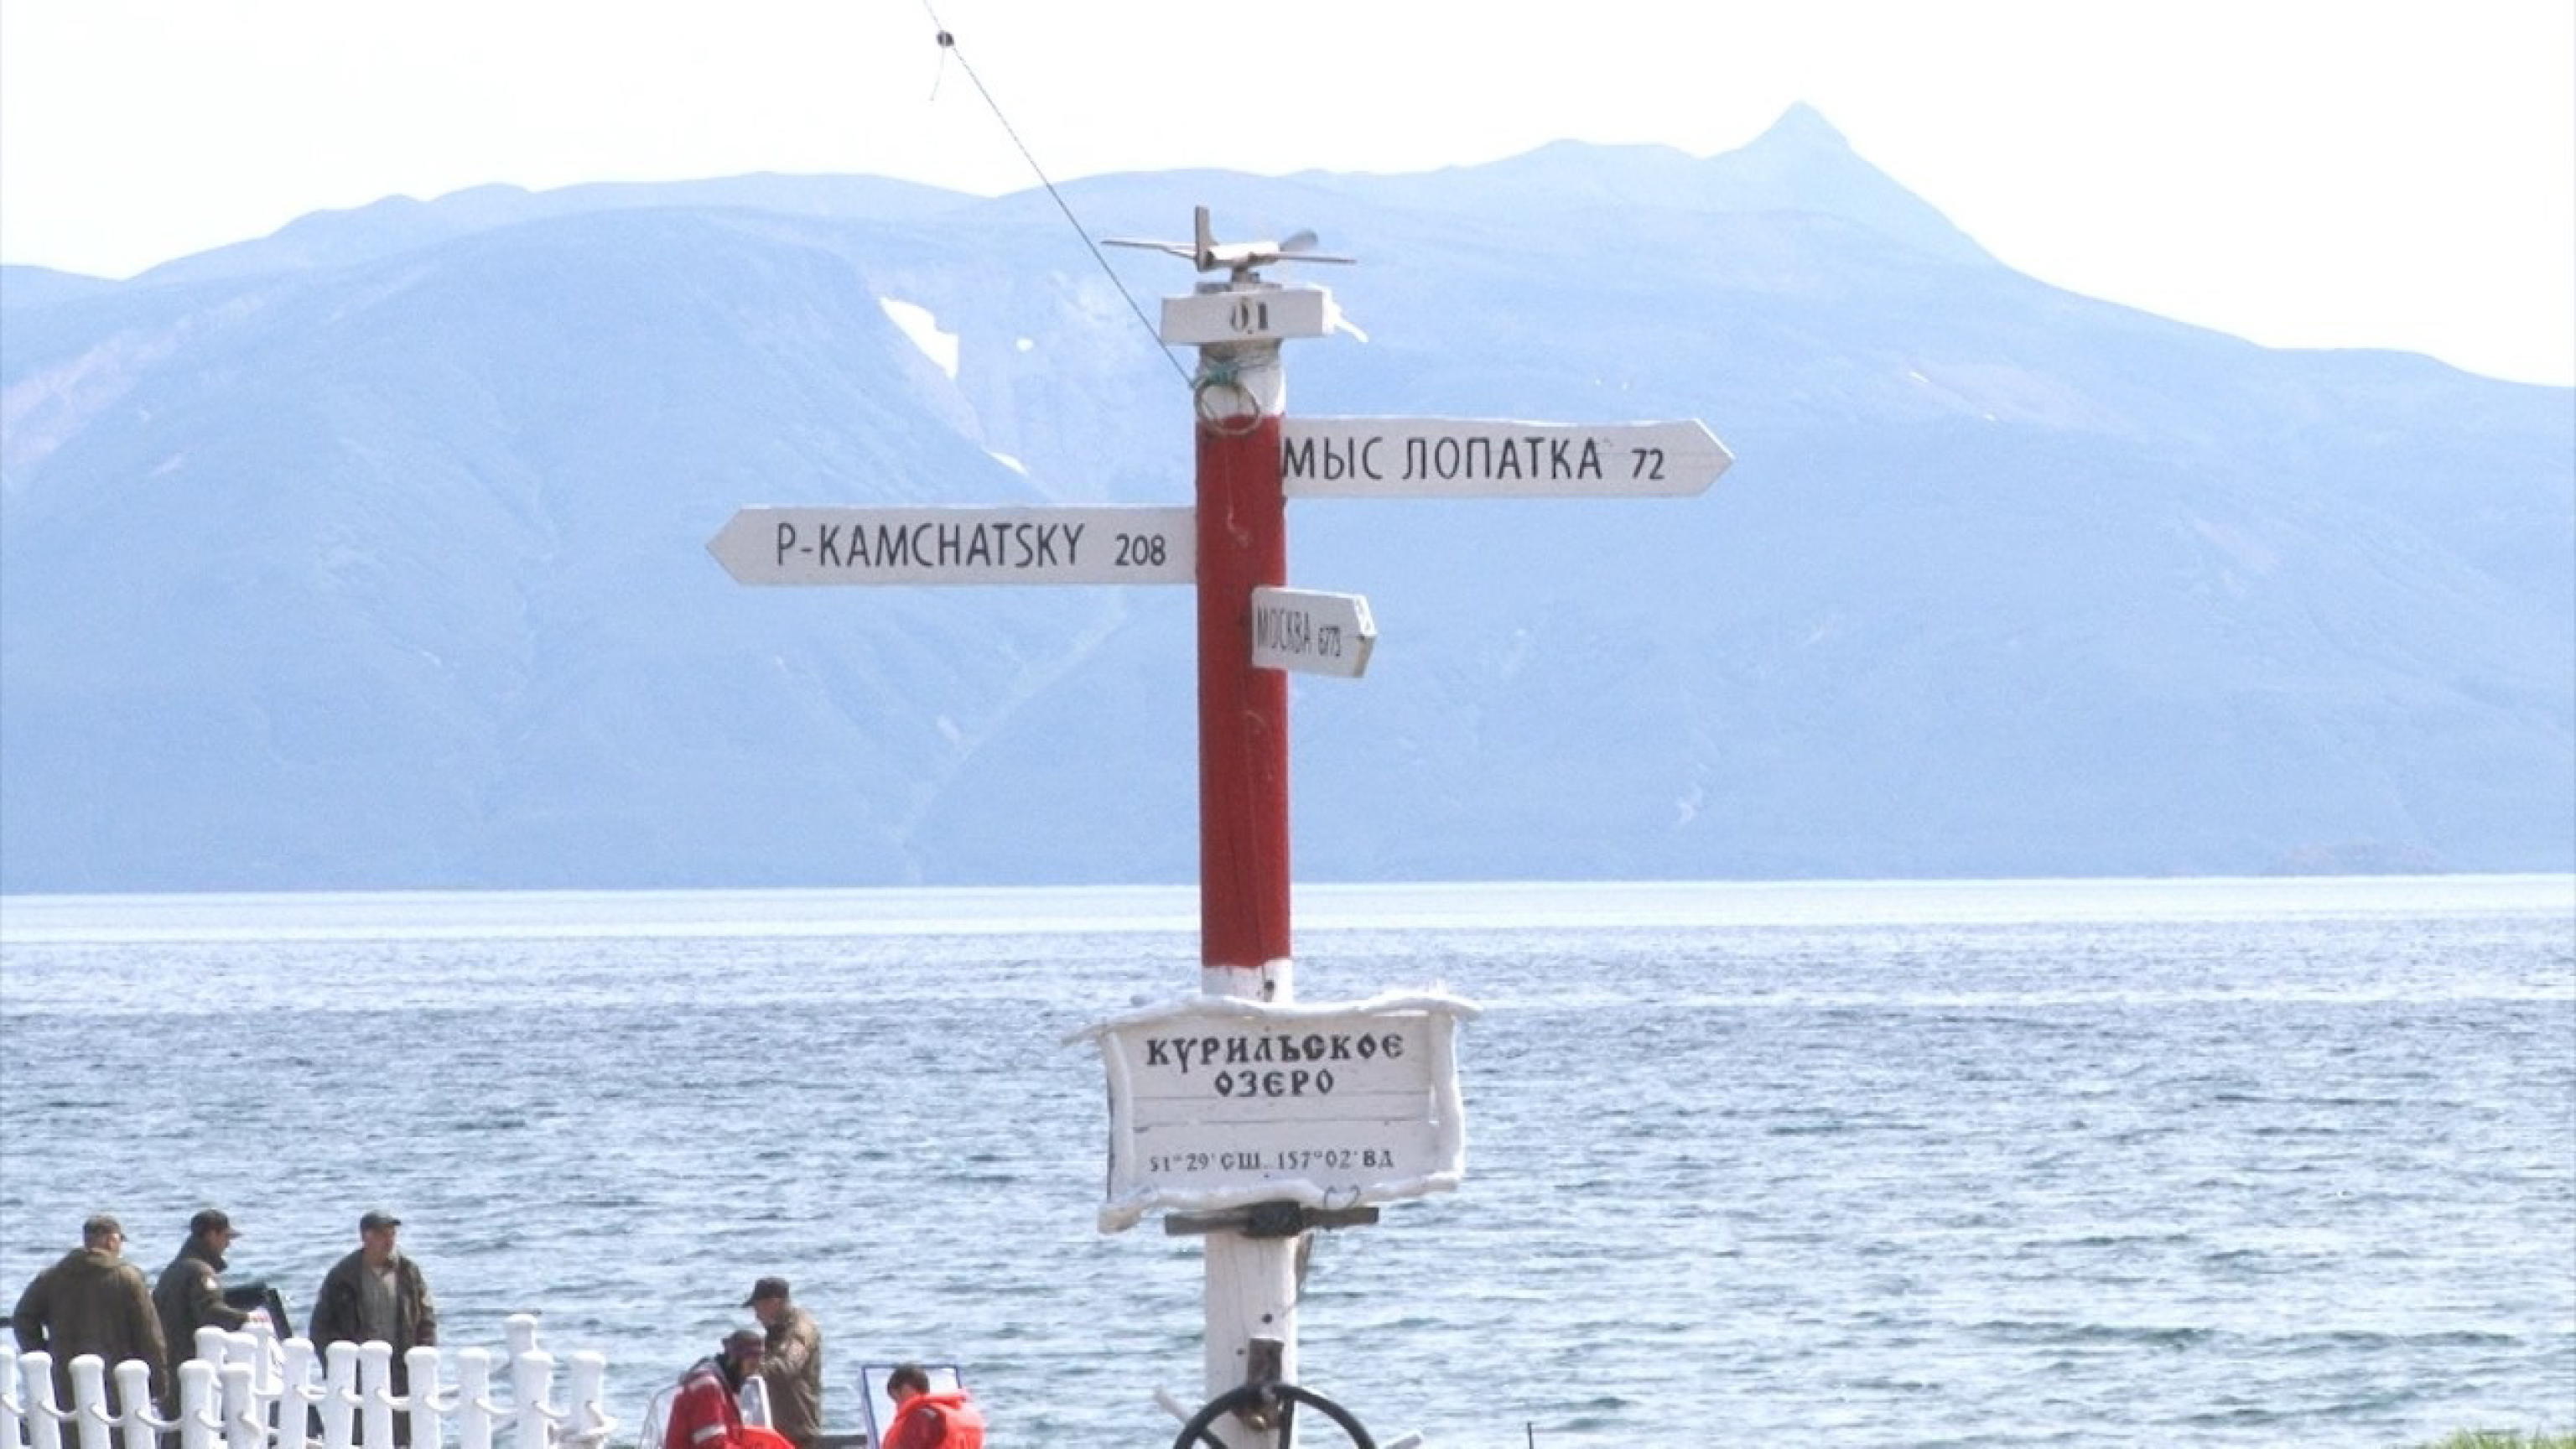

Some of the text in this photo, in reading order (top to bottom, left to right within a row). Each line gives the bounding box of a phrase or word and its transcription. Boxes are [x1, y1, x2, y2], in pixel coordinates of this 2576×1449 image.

[1282, 436, 1665, 480] МЫС ЛОПАТКА 72
[777, 522, 1166, 568] P-KAMCHATSKY 208
[1257, 605, 1312, 654] МОСКВА
[1214, 1068, 1335, 1098] ОЗЕРО
